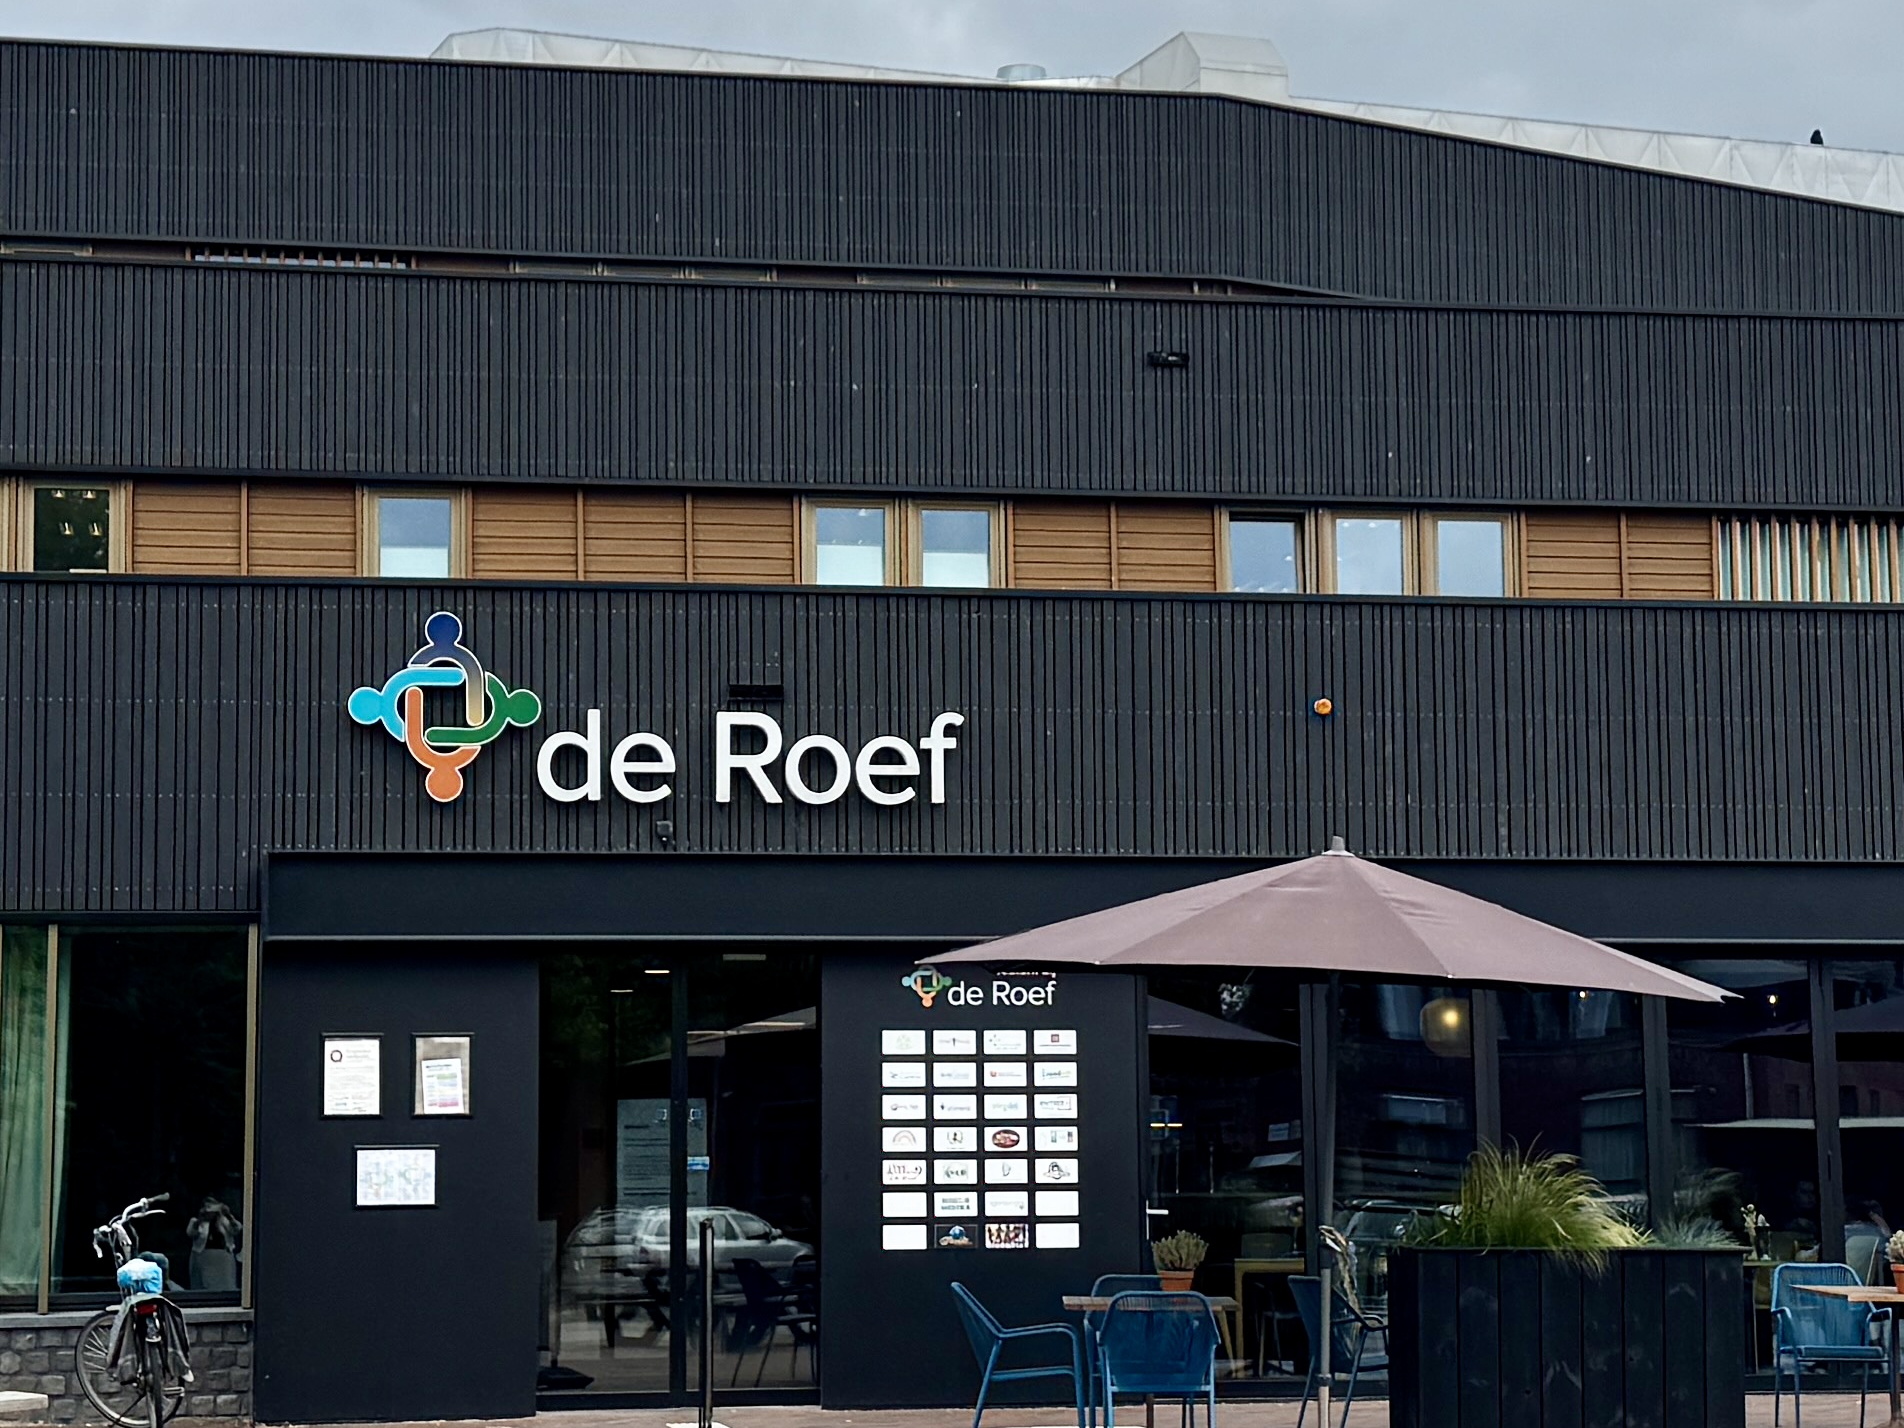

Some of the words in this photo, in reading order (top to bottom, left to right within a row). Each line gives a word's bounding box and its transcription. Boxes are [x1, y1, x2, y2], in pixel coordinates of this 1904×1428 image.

[536, 708, 677, 804] de
[715, 710, 965, 806] Roef
[947, 980, 984, 1006] de
[992, 980, 1057, 1006] Roef
